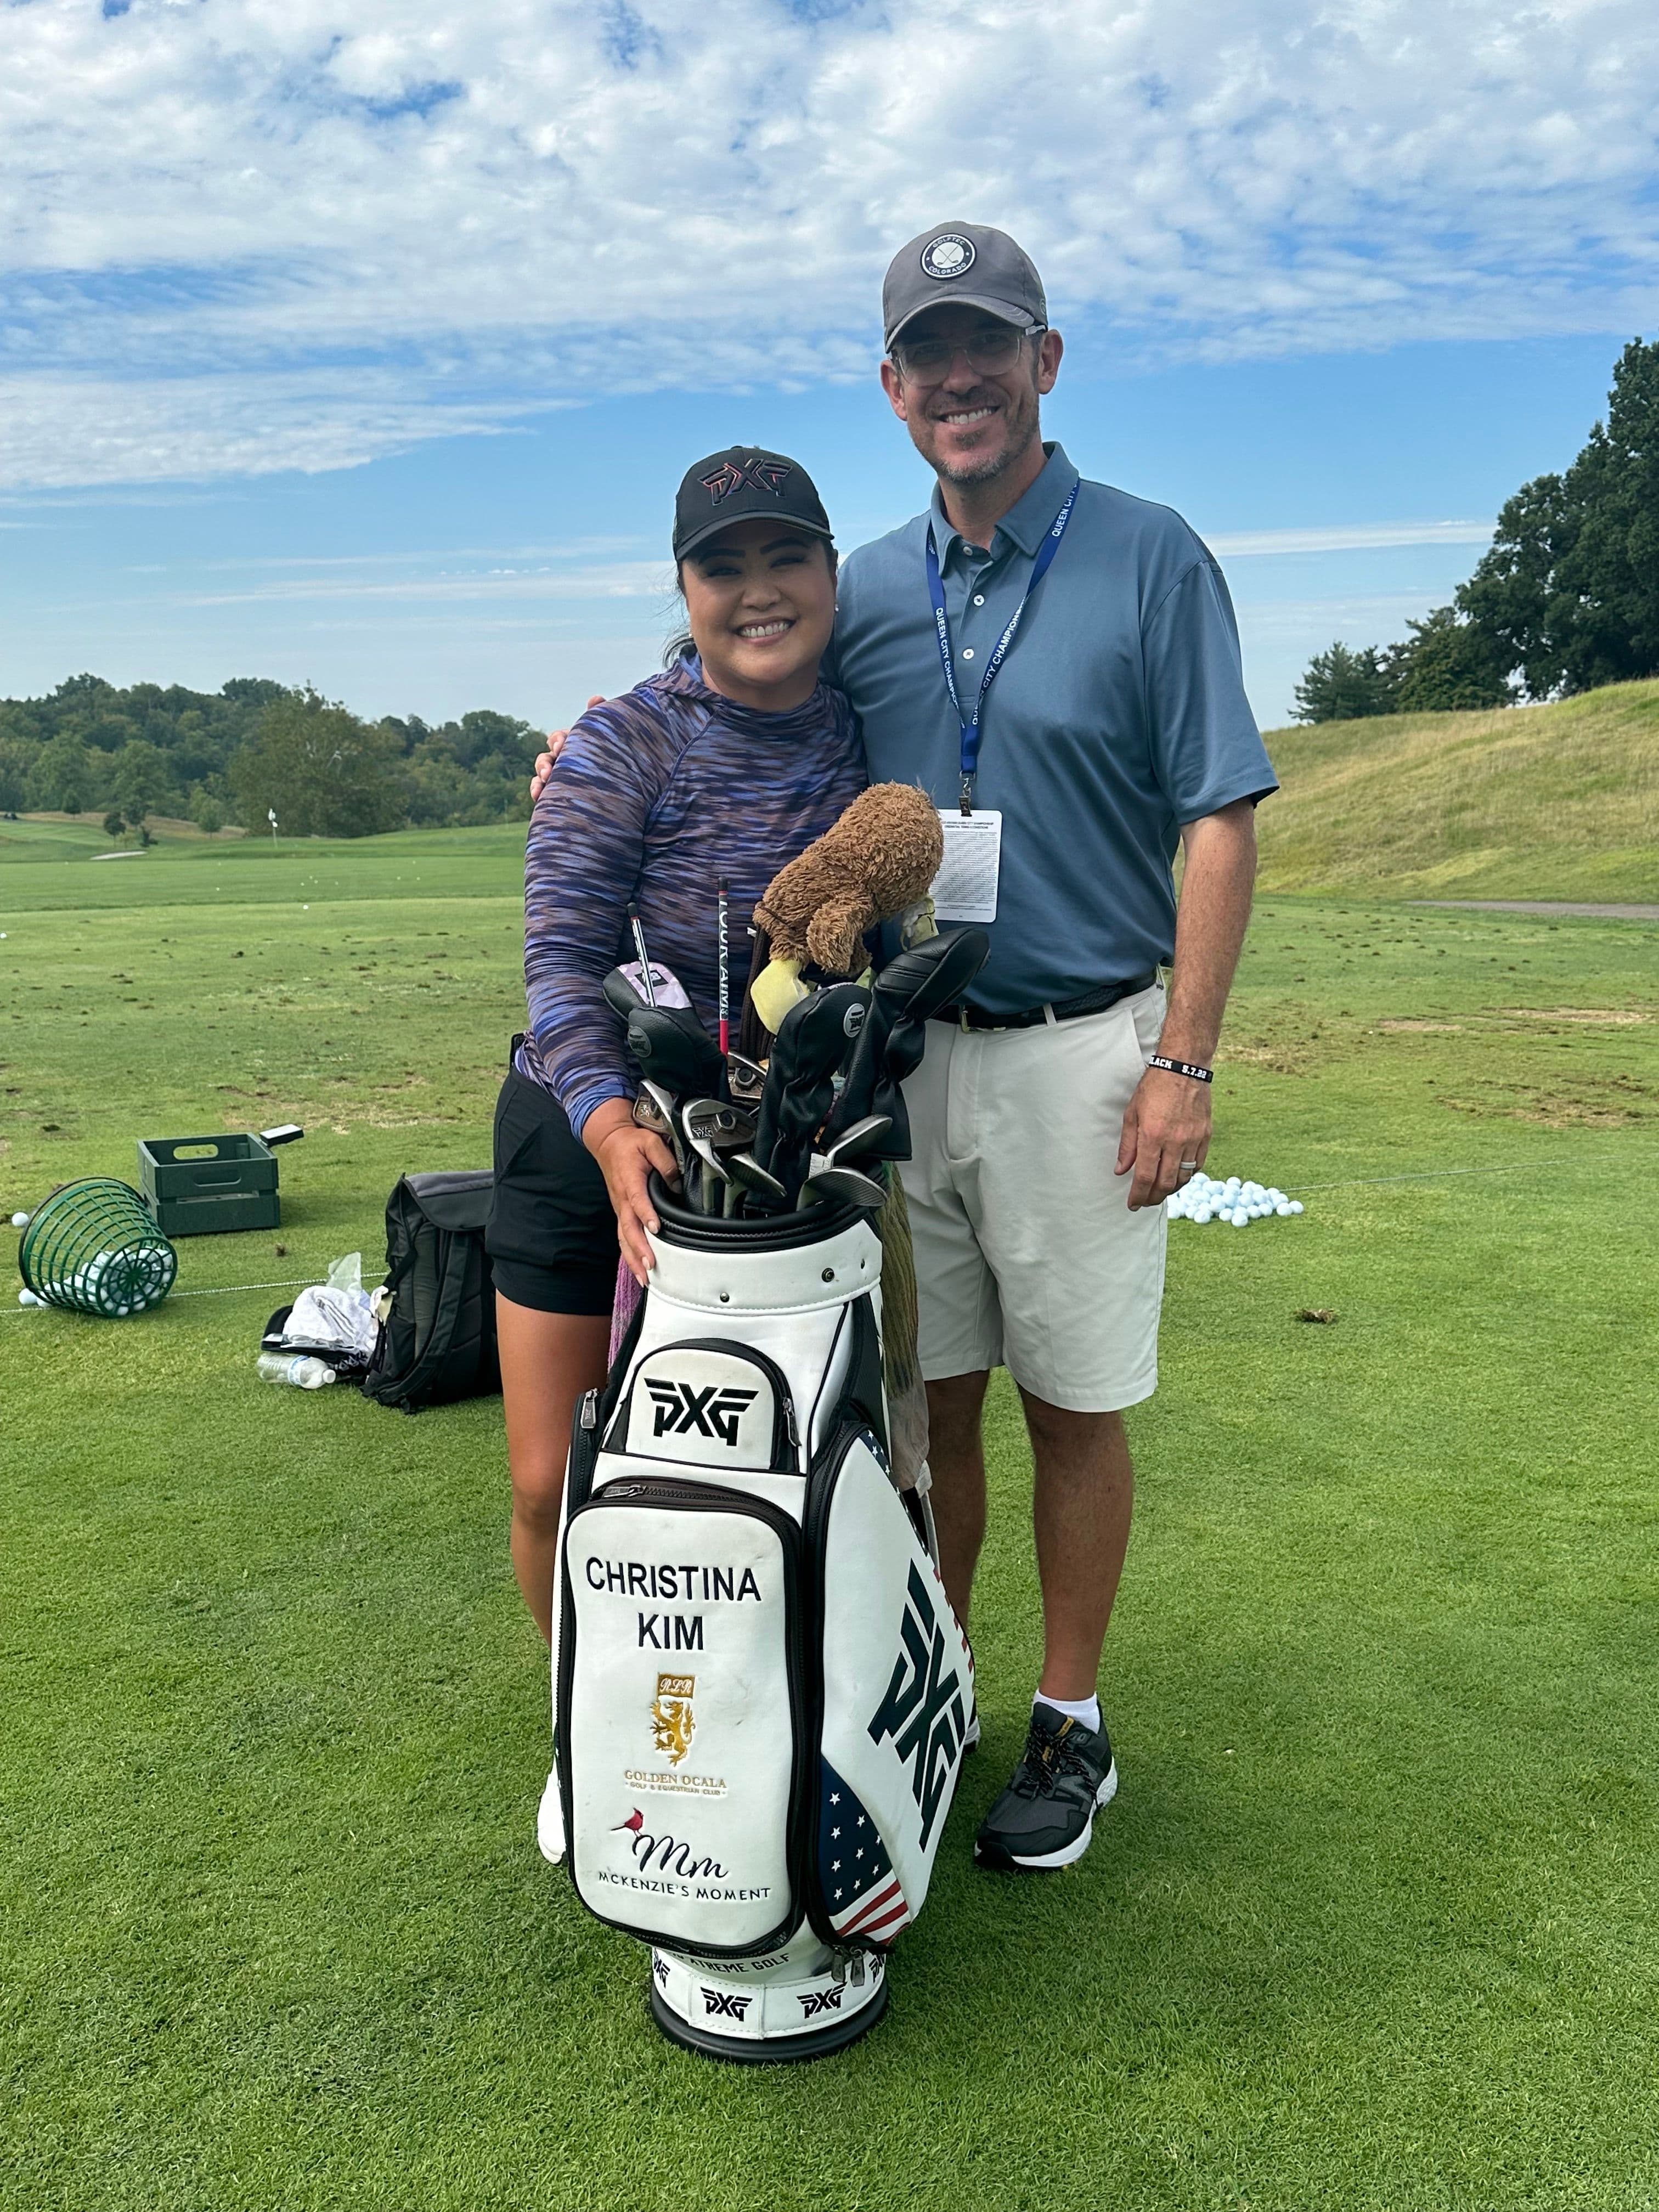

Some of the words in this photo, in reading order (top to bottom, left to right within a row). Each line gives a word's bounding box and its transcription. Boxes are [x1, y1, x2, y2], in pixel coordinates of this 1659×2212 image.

[933, 237, 965, 247] GOLFTEC
[929, 262, 966, 274] COLORADO
[697, 459, 793, 505] PXG
[1052, 509, 1069, 537] QUEEN
[936, 607, 946, 639] QUEEN
[941, 639, 950, 659] CITY
[983, 665, 996, 688] CITY
[644, 1378, 759, 1447] PXG
[586, 1556, 761, 1601] CHRISTINA
[637, 1612, 704, 1650] KIM
[624, 1770, 678, 1784] GOLDEN
[682, 1776, 727, 1788] OCALA
[658, 1785, 699, 1794] EQUESTRIAN
[632, 1835, 729, 1878] Mm
[599, 1871, 690, 1897] MCKENZIE'S
[696, 1888, 771, 1901] MOMENT
[751, 1953, 791, 1970] GOLF
[700, 1987, 753, 2022] PXG
[797, 1982, 848, 2019] PXG
